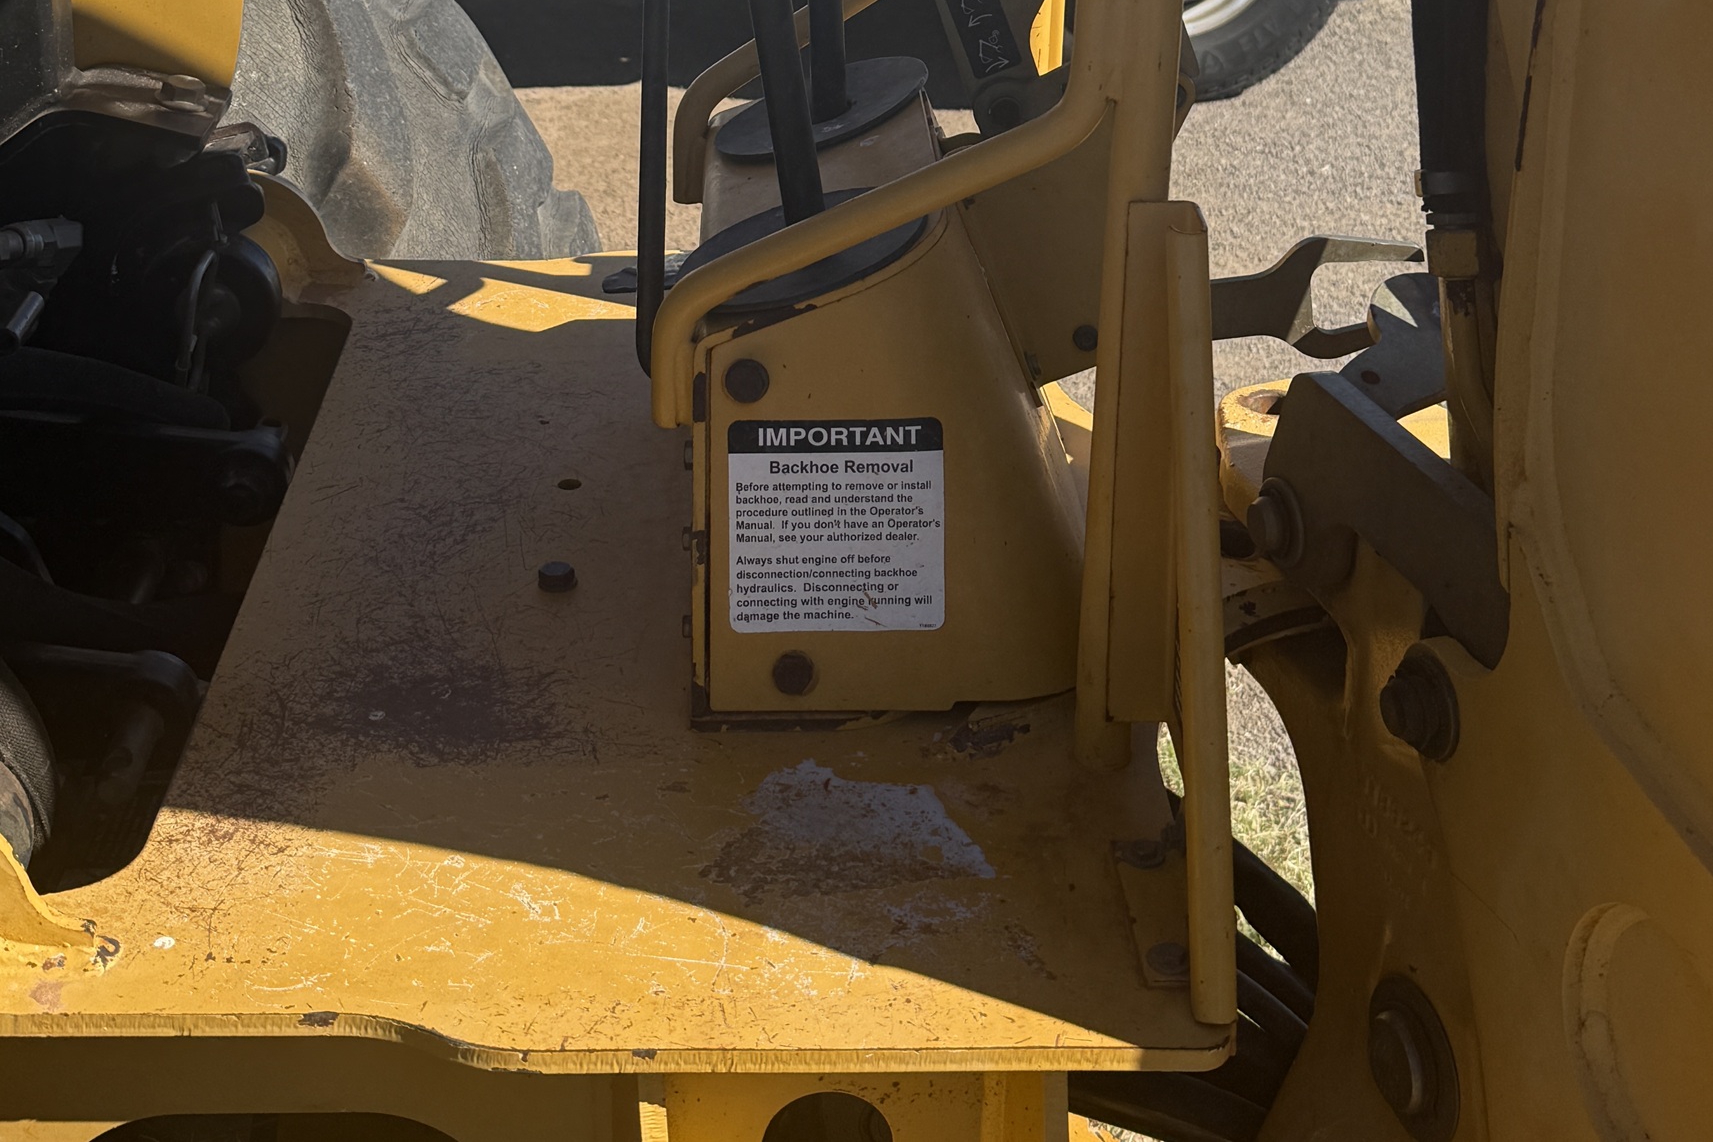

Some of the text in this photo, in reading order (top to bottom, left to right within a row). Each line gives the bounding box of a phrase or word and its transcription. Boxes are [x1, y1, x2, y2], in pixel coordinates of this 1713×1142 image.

[758, 425, 921, 446] IMPORTANT
[769, 460, 913, 474] Backhoe Removal
[736, 483, 769, 492] Before
[772, 482, 828, 492] attempting
[832, 482, 842, 490] to
[901, 481, 932, 489] install
[736, 494, 913, 505] backhoe, read and understand the
[736, 506, 923, 518] procedure outlined in the Operator's
[736, 521, 775, 530] Manual.
[782, 521, 789, 529] If
[791, 521, 810, 531] you
[814, 520, 841, 529] don't
[844, 520, 868, 528] have
[887, 519, 940, 530] Operator's
[736, 532, 919, 544] Manual, see your authorized dealer.
[737, 555, 890, 566] Always shut engine off before
[737, 568, 917, 580] disconnection/connecting backhoe
[737, 584, 797, 594] hydraulics.
[803, 582, 884, 593] Disconnecting
[737, 596, 932, 608] connecting with engine running will
[737, 610, 854, 623] damage the machine.
